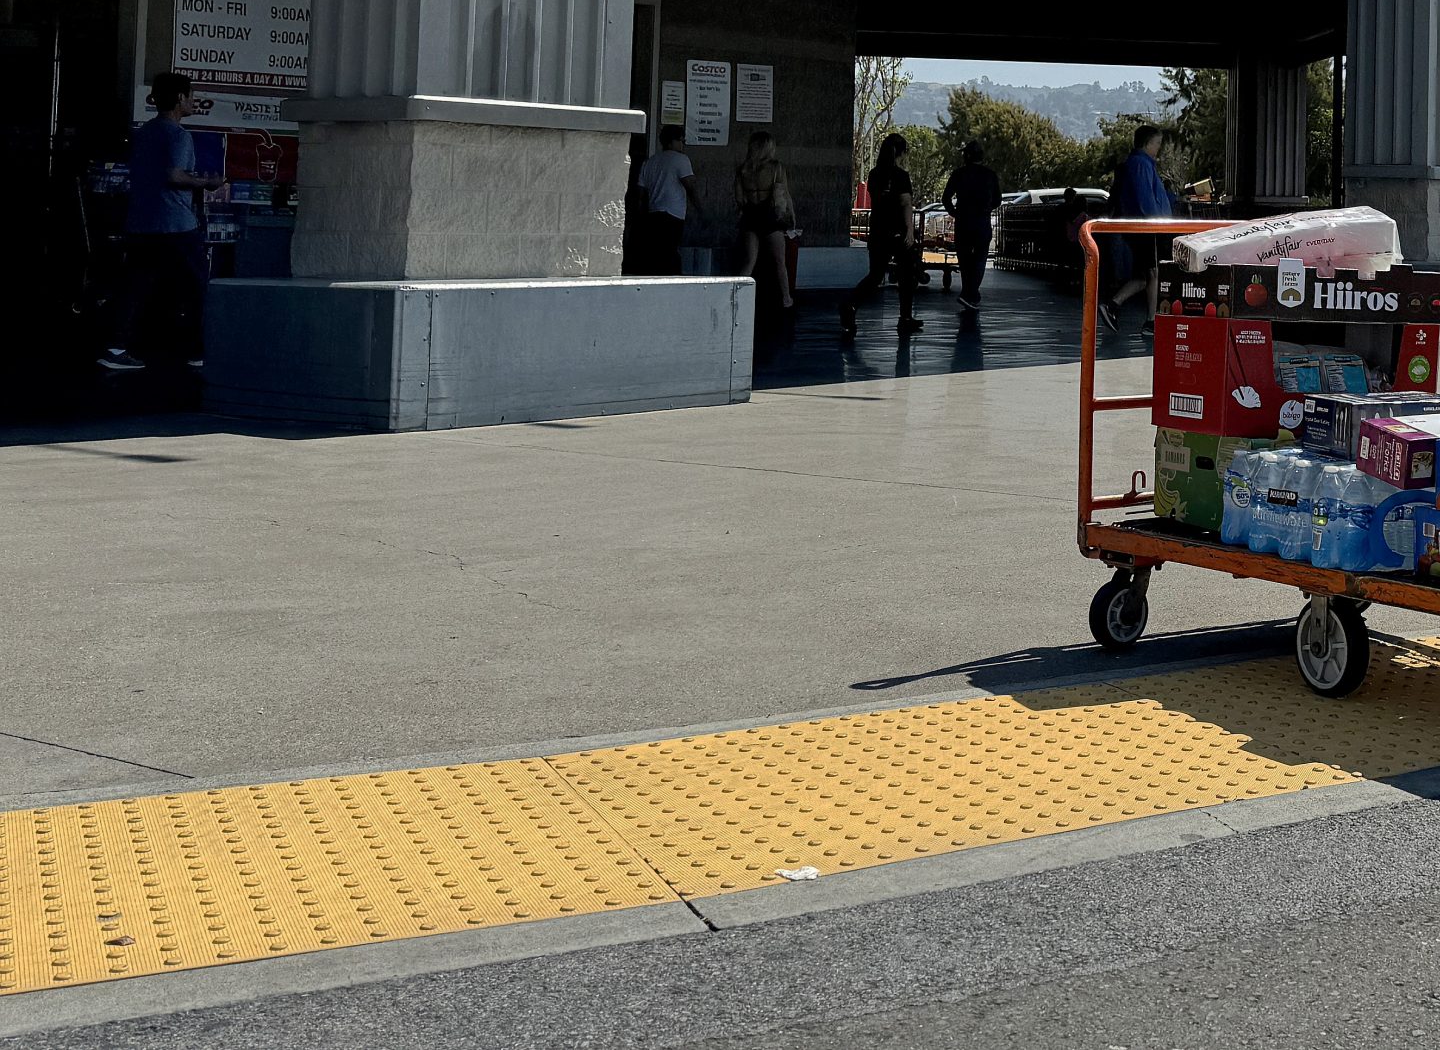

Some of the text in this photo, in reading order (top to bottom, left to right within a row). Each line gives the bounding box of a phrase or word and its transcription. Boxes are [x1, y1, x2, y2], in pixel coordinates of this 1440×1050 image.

[227, 1, 247, 16] FRI
[181, 22, 252, 41] SATURDAY
[180, 48, 307, 69] SUNDAY 9:00A
[692, 63, 726, 74] COSTCO
[202, 70, 213, 81] 24
[215, 71, 243, 84] HOURS
[244, 73, 251, 84] A
[254, 73, 271, 85] DAY
[272, 74, 284, 86] AT
[234, 102, 271, 113] WASTE
[1203, 254, 1218, 265] 660
[1182, 282, 1206, 298] Hiiros
[1313, 281, 1399, 312] Hiiros
[1283, 412, 1300, 420] bibigo
